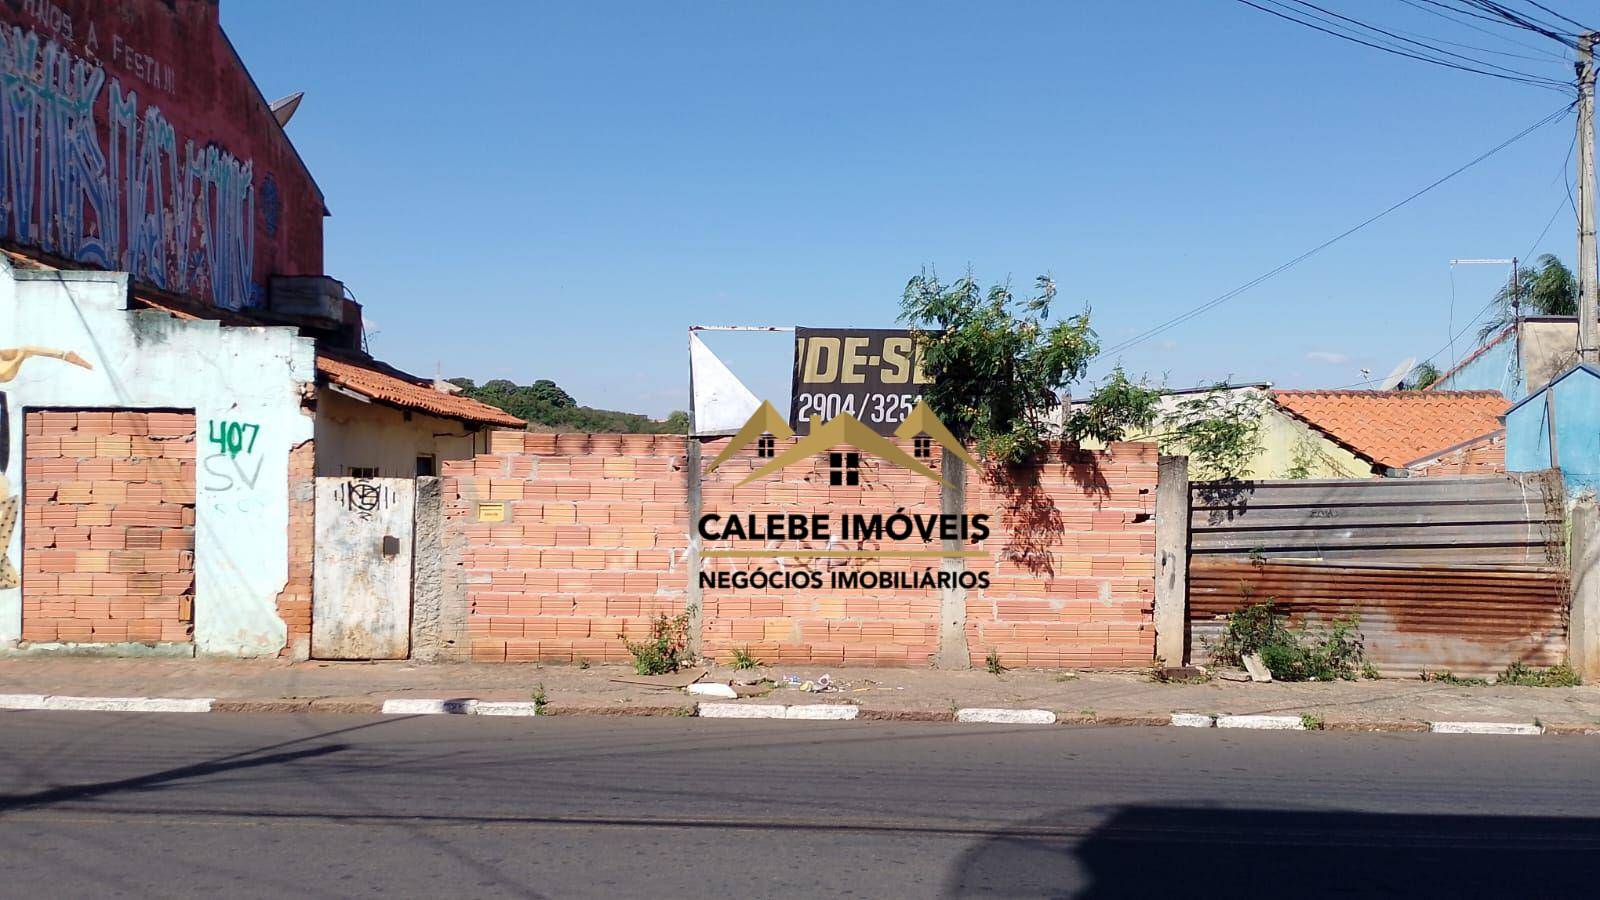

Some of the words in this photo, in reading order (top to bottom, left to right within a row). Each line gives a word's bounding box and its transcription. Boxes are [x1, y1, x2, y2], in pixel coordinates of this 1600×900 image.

[87, 20, 99, 50] A
[798, 392, 922, 423] 2904/325
[208, 419, 260, 459] 407
